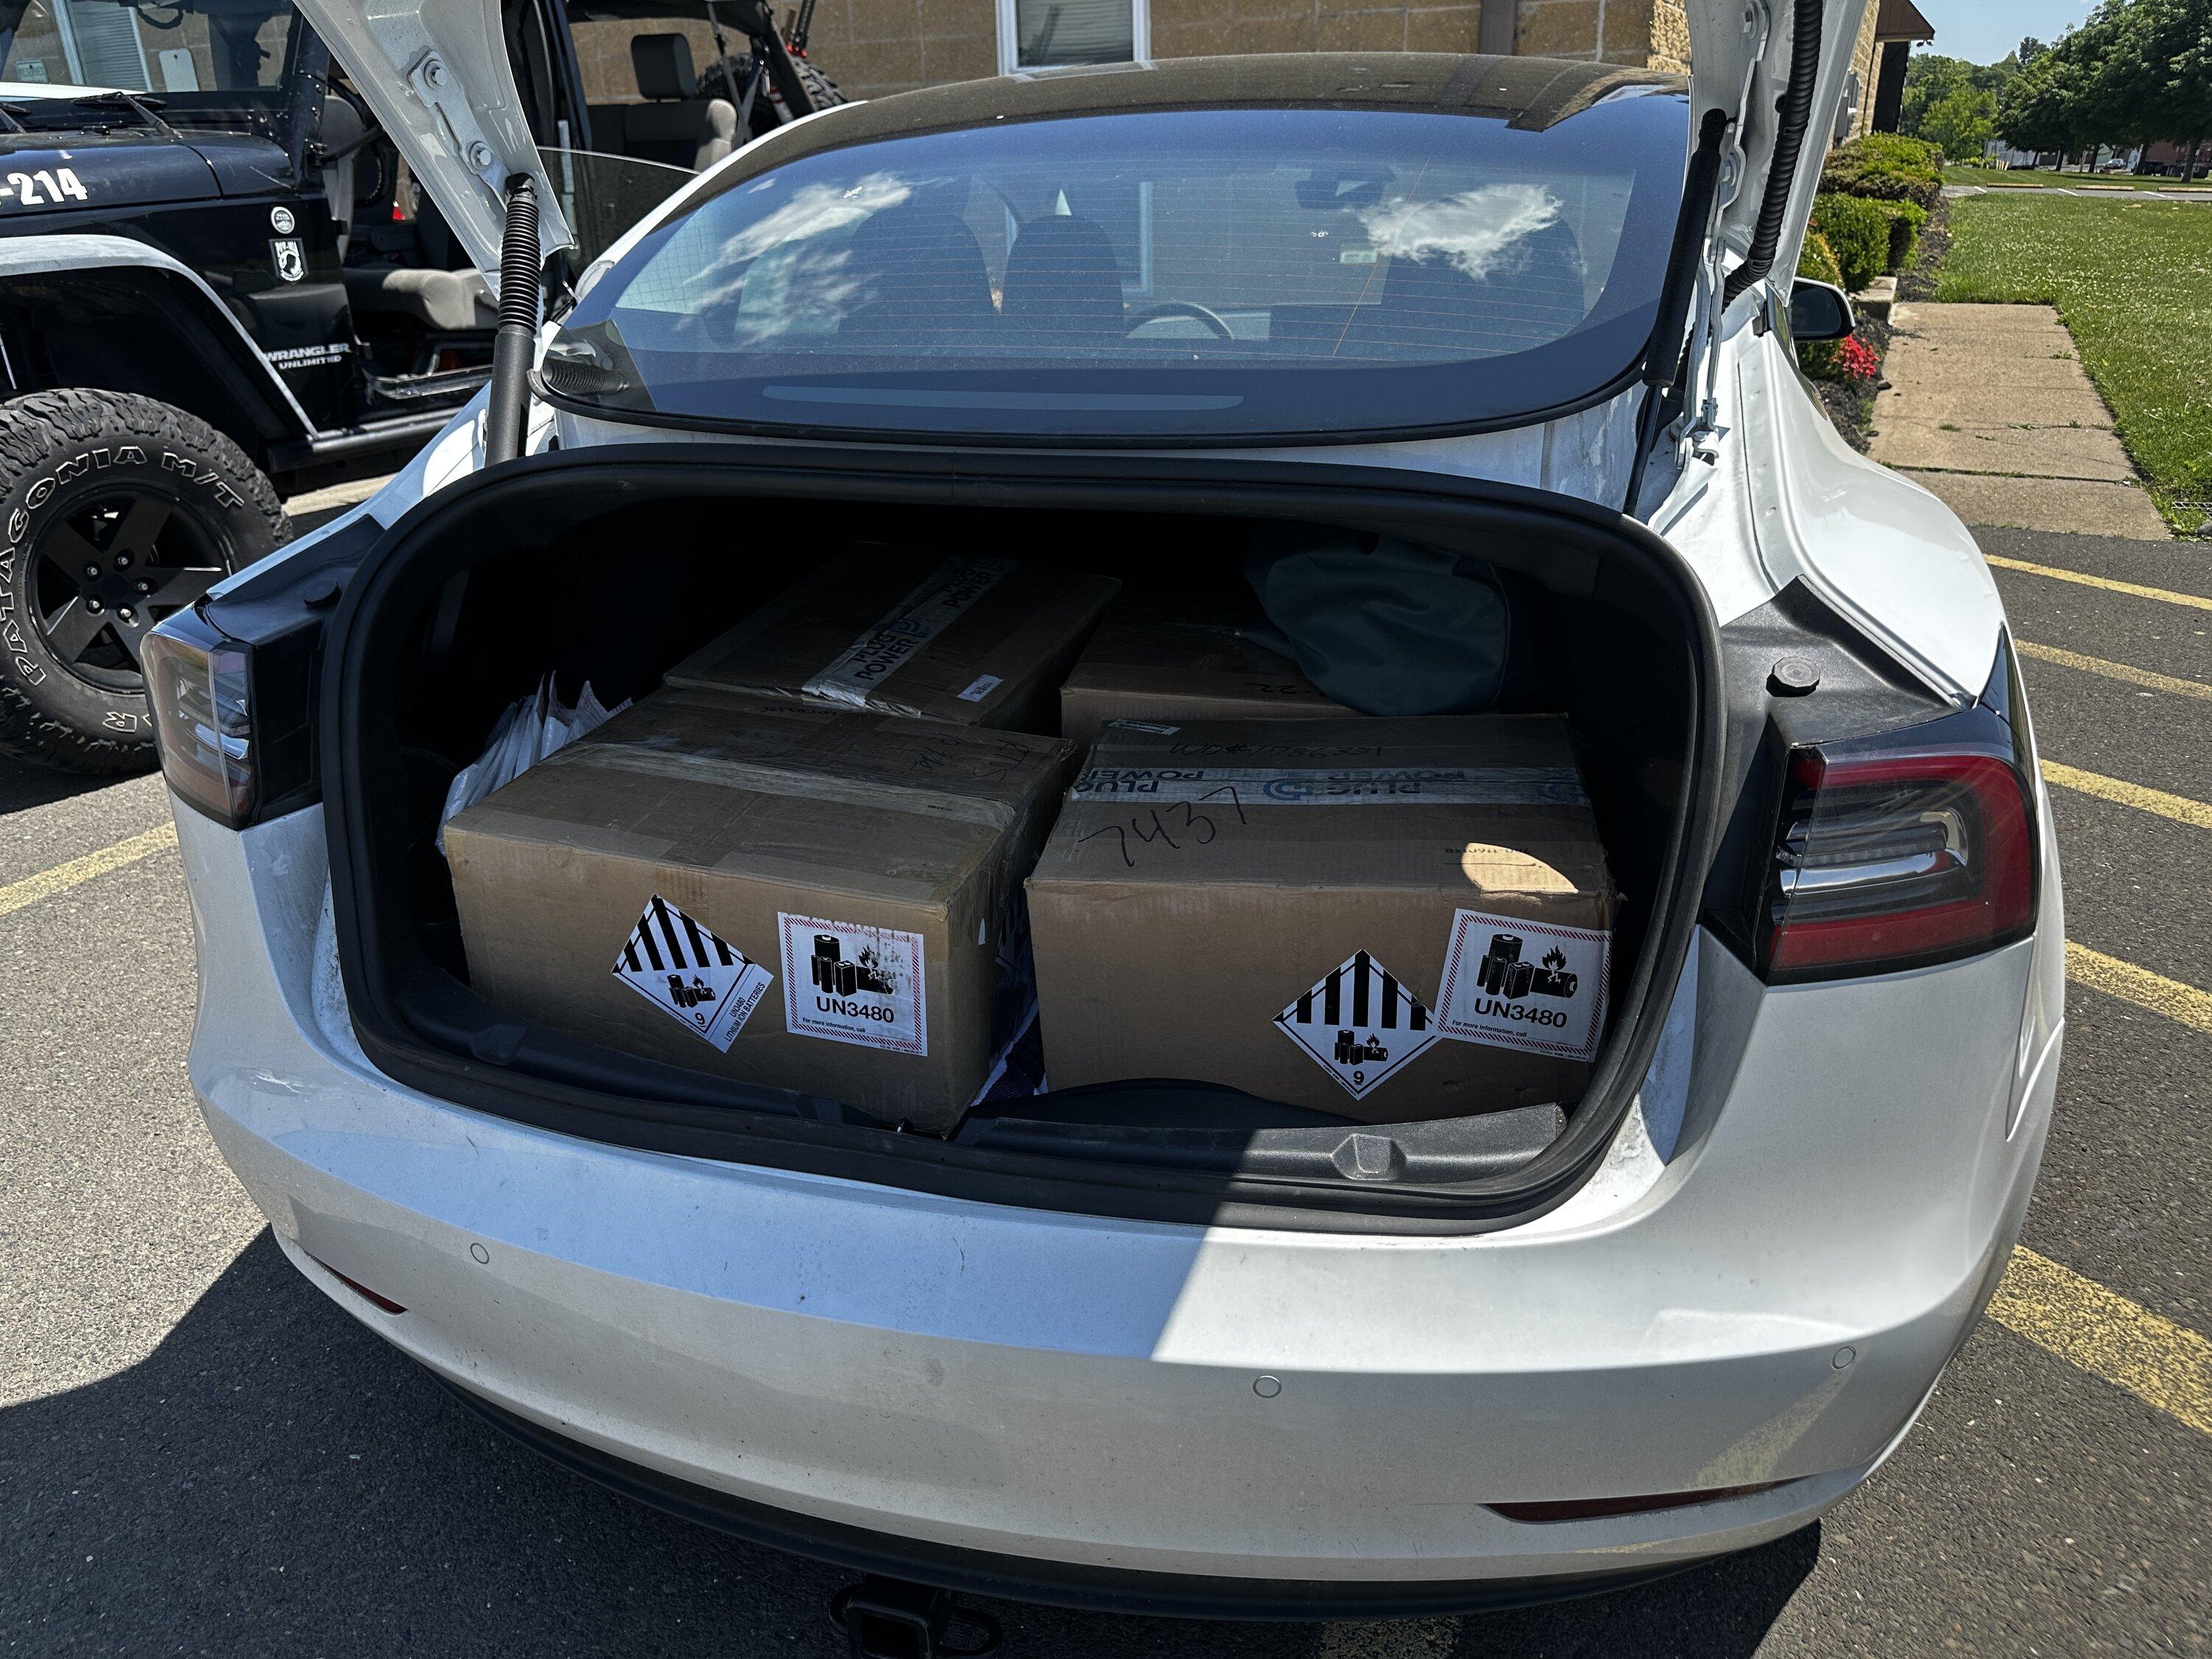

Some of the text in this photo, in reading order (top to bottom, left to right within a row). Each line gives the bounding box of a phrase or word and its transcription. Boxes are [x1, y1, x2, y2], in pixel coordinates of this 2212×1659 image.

[264, 342, 352, 361] WRANGLER
[278, 355, 342, 369] UNLIMITED
[0, 445, 245, 686] PATAGONIA M/T
[854, 639, 919, 681] POWER
[695, 1012, 706, 1025] 9
[725, 981, 765, 1042] LITHIUM ION BATTERIES
[816, 996, 894, 1023] UN3480
[1475, 998, 1568, 1028] UN3480
[1479, 1024, 1514, 1037] information,
[1353, 1071, 1365, 1084] 9
